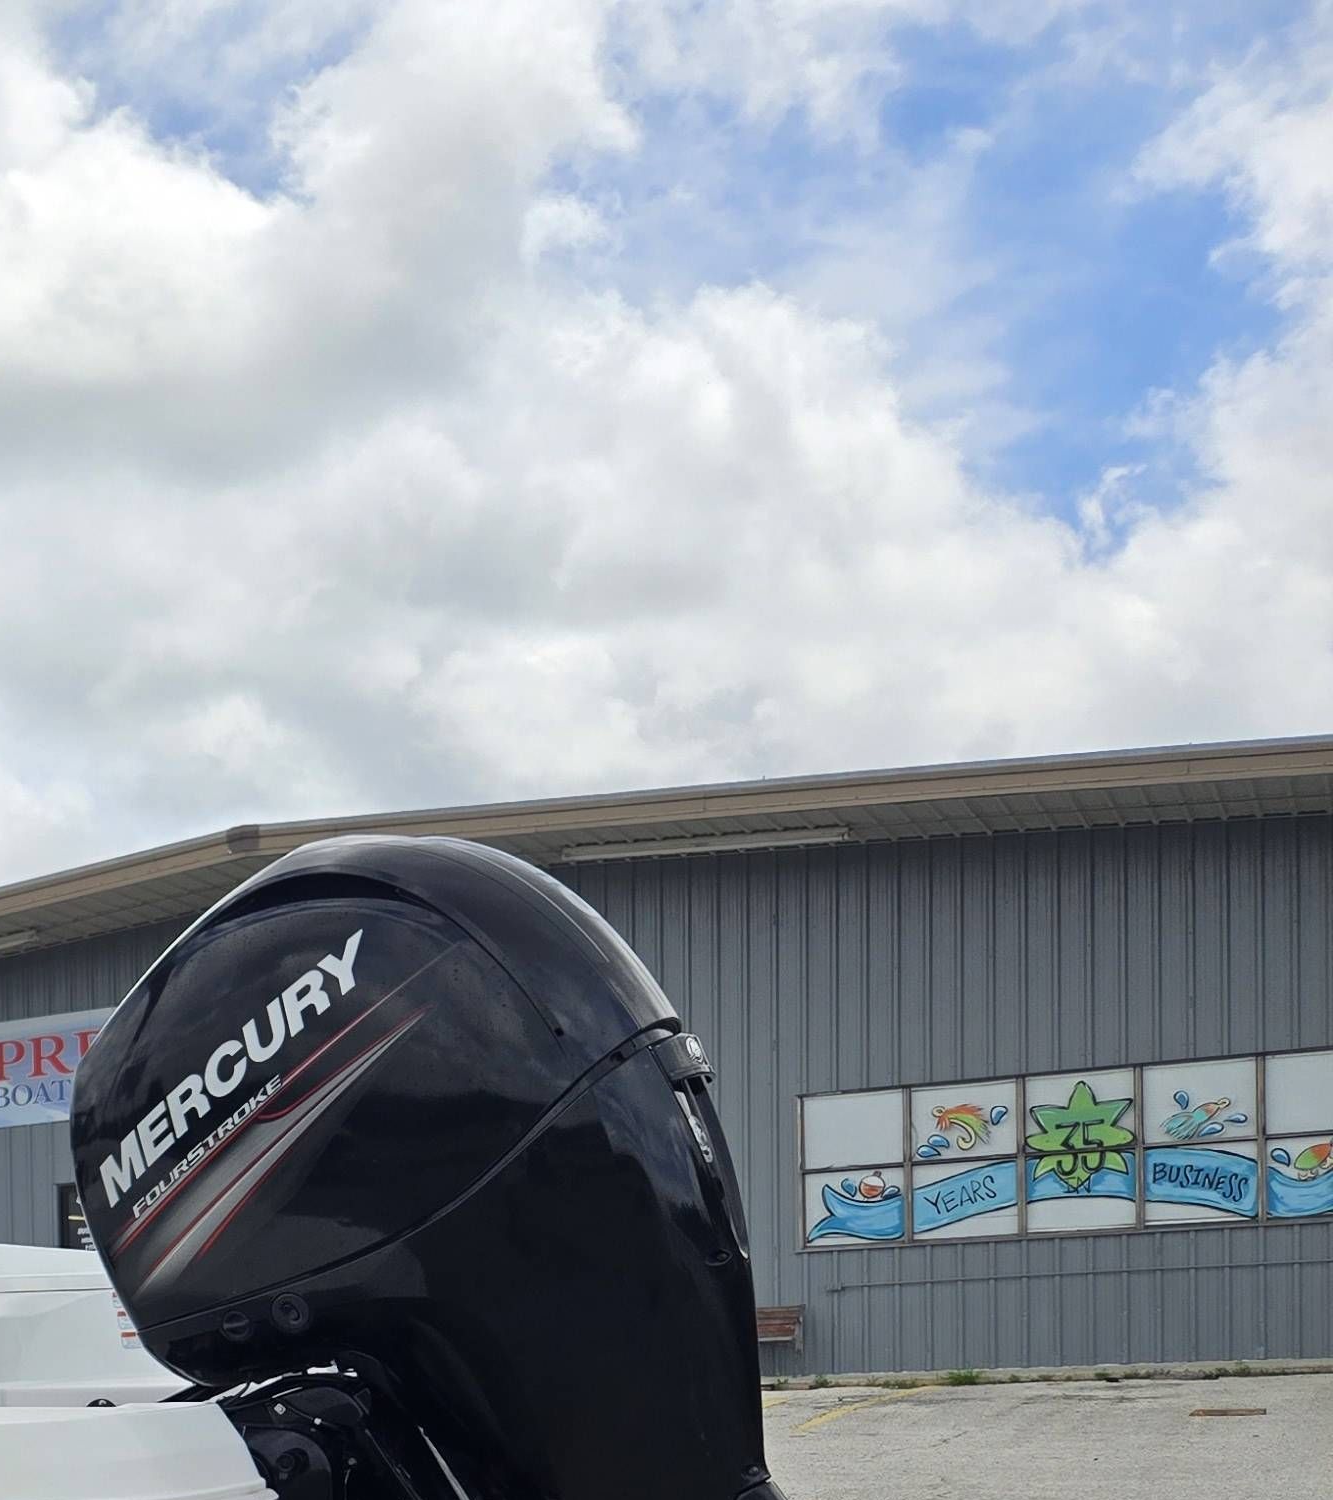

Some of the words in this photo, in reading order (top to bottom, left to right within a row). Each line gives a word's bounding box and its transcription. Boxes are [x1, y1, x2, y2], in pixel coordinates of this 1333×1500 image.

[99, 928, 364, 1209] MERCURY
[133, 1074, 283, 1219] FOURSTROKE
[923, 1174, 997, 1215] YEARS
[1152, 1162, 1249, 1202] BUSINESS
